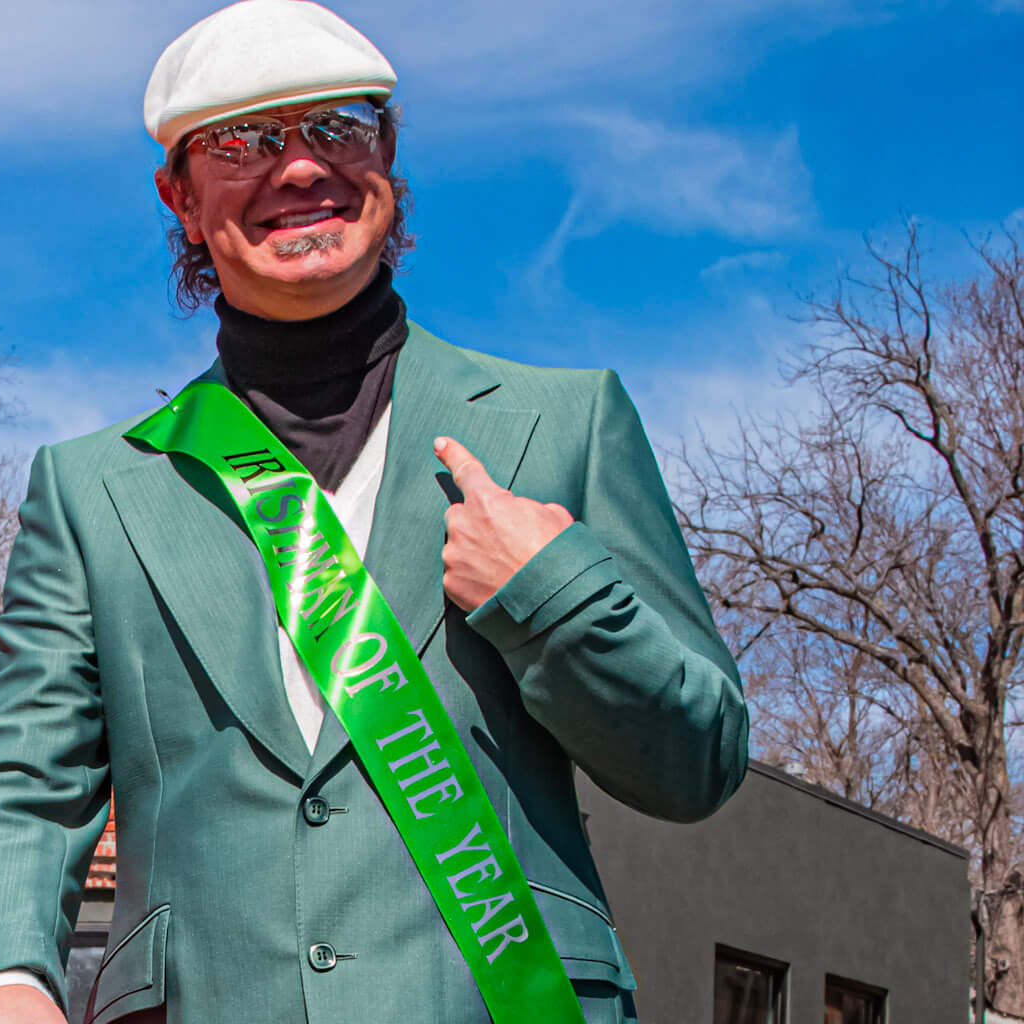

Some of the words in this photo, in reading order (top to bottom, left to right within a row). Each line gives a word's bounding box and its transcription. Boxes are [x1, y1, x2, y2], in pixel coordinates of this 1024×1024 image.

[331, 632, 408, 698] OF
[376, 709, 464, 820] THE
[435, 822, 528, 964] YEAR
